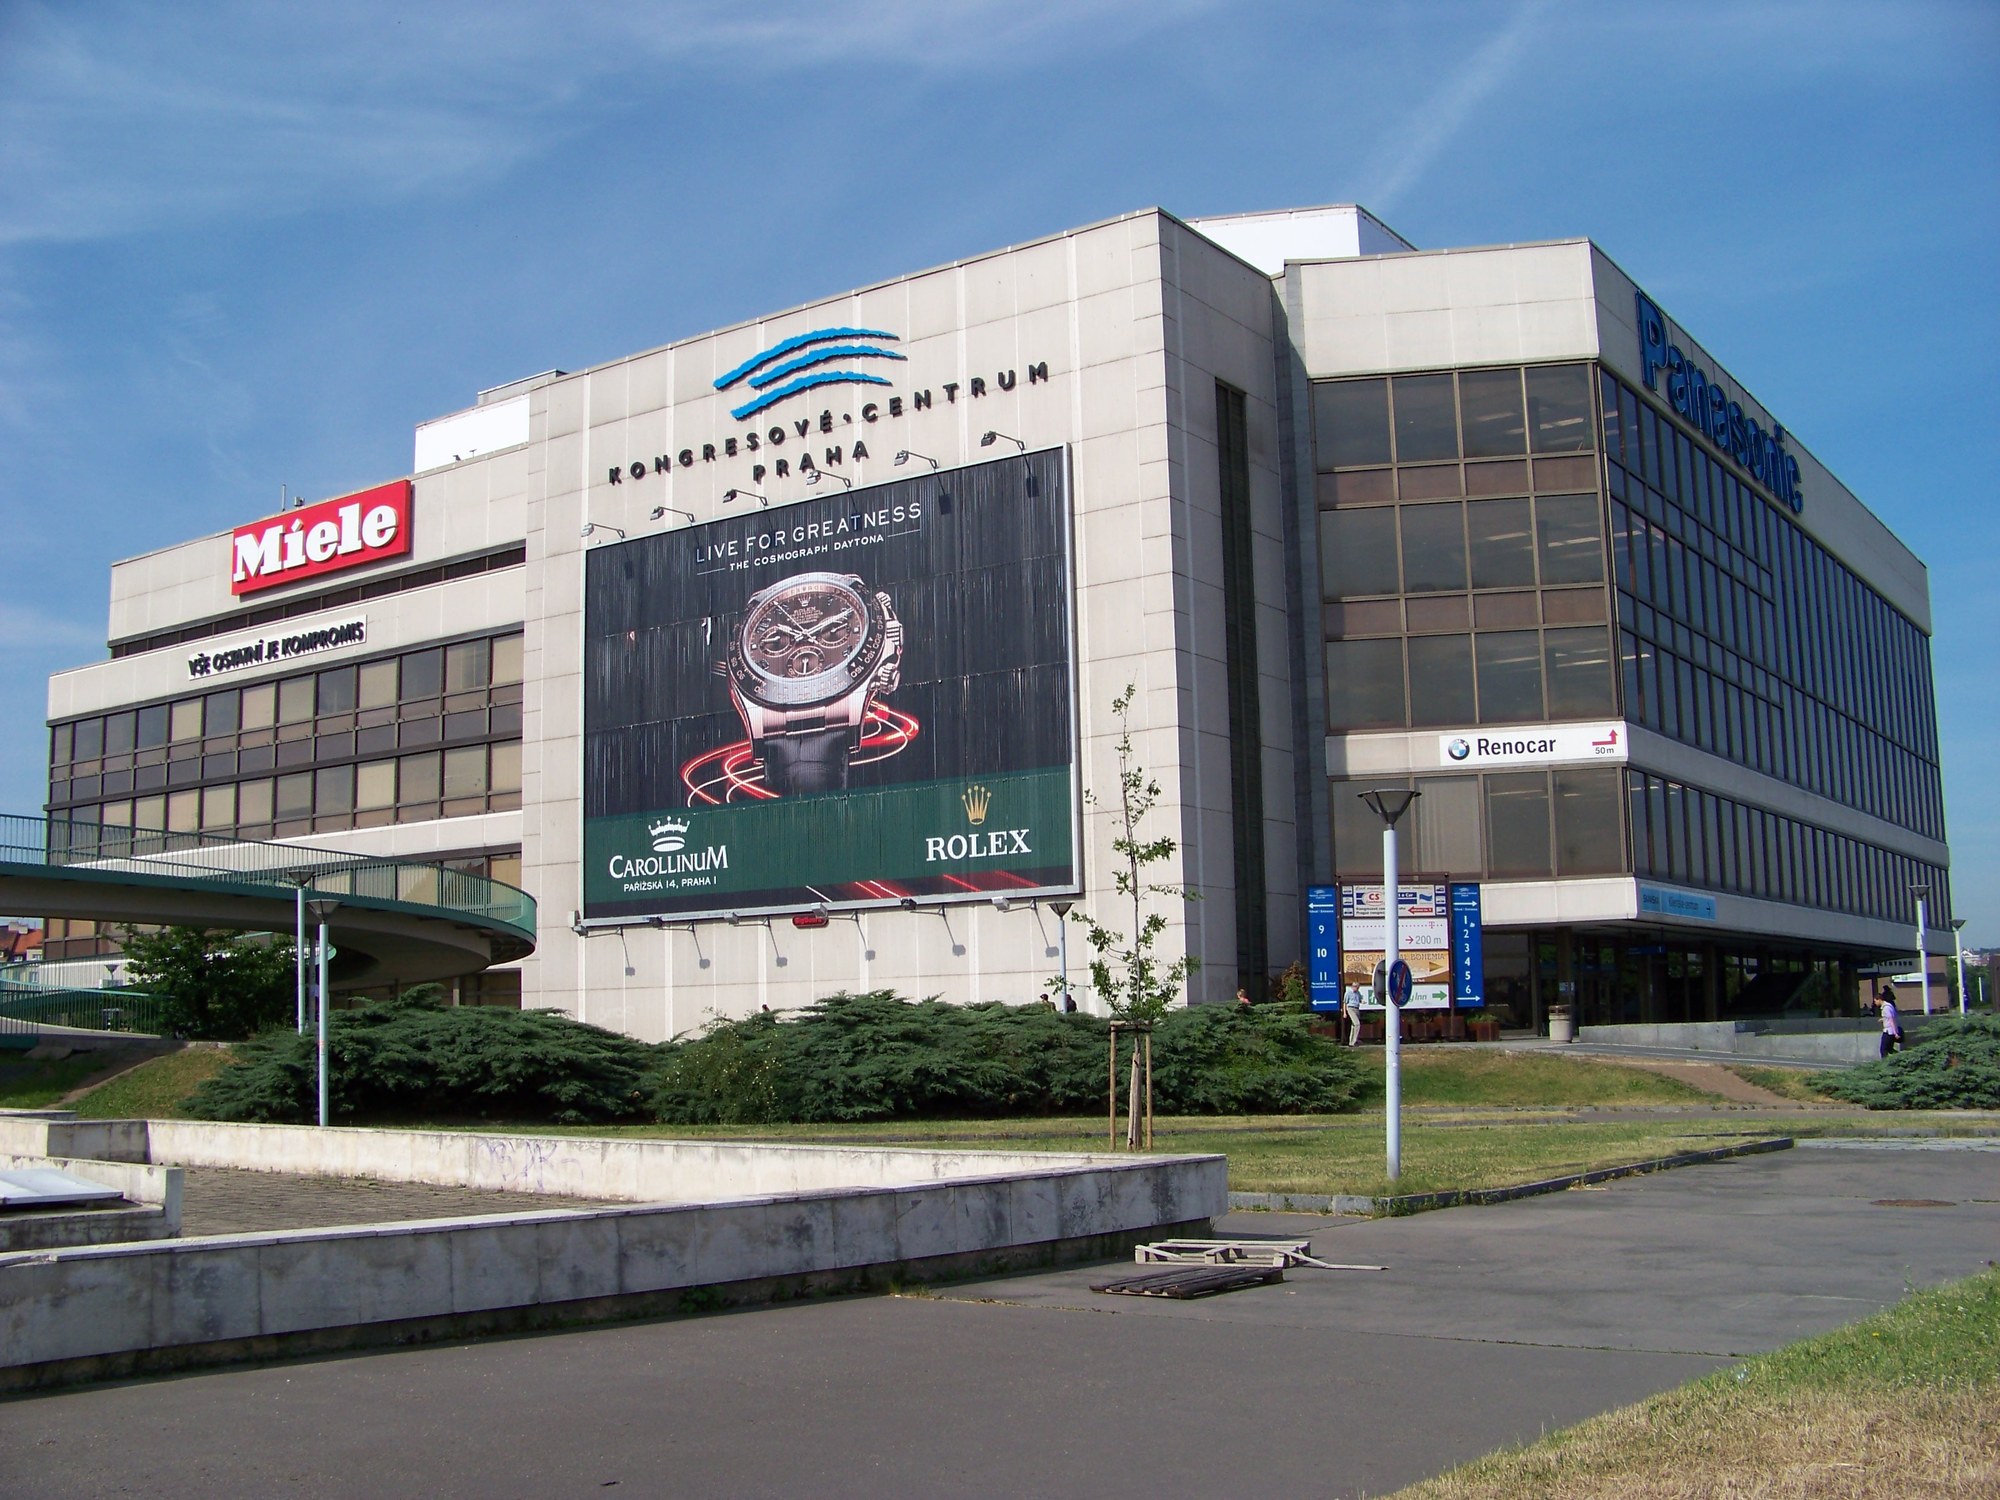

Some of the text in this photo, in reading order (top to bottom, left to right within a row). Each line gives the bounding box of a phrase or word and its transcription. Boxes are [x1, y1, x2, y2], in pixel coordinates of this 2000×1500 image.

[1635, 289, 1804, 514] Panasonic
[609, 361, 1049, 485] KONGRESOVÉ CENTRUM
[753, 440, 869, 483] PRAHA
[696, 502, 922, 564] LIVE FOR GREATNESS
[233, 502, 399, 583] Miele
[730, 533, 885, 572] THE COSMOGRAPH DAYTONA
[265, 639, 280, 661] JE
[281, 621, 364, 657] KOMPROMIS
[1477, 738, 1556, 756] Renocar
[925, 829, 1032, 861] ROLEX
[681, 876, 711, 887] PRAHA
[1463, 915, 1468, 925] 1
[1318, 925, 1325, 935] 9
[1463, 929, 1470, 939] 2
[1415, 935, 1432, 945] 200
[1317, 948, 1327, 958] 10
[1464, 943, 1470, 953] 3
[1345, 953, 1374, 962] CASINO
[1410, 952, 1445, 961] BOHEMIA
[1464, 957, 1471, 967] 4
[1464, 971, 1471, 981] 5
[1465, 985, 1472, 995] 6
